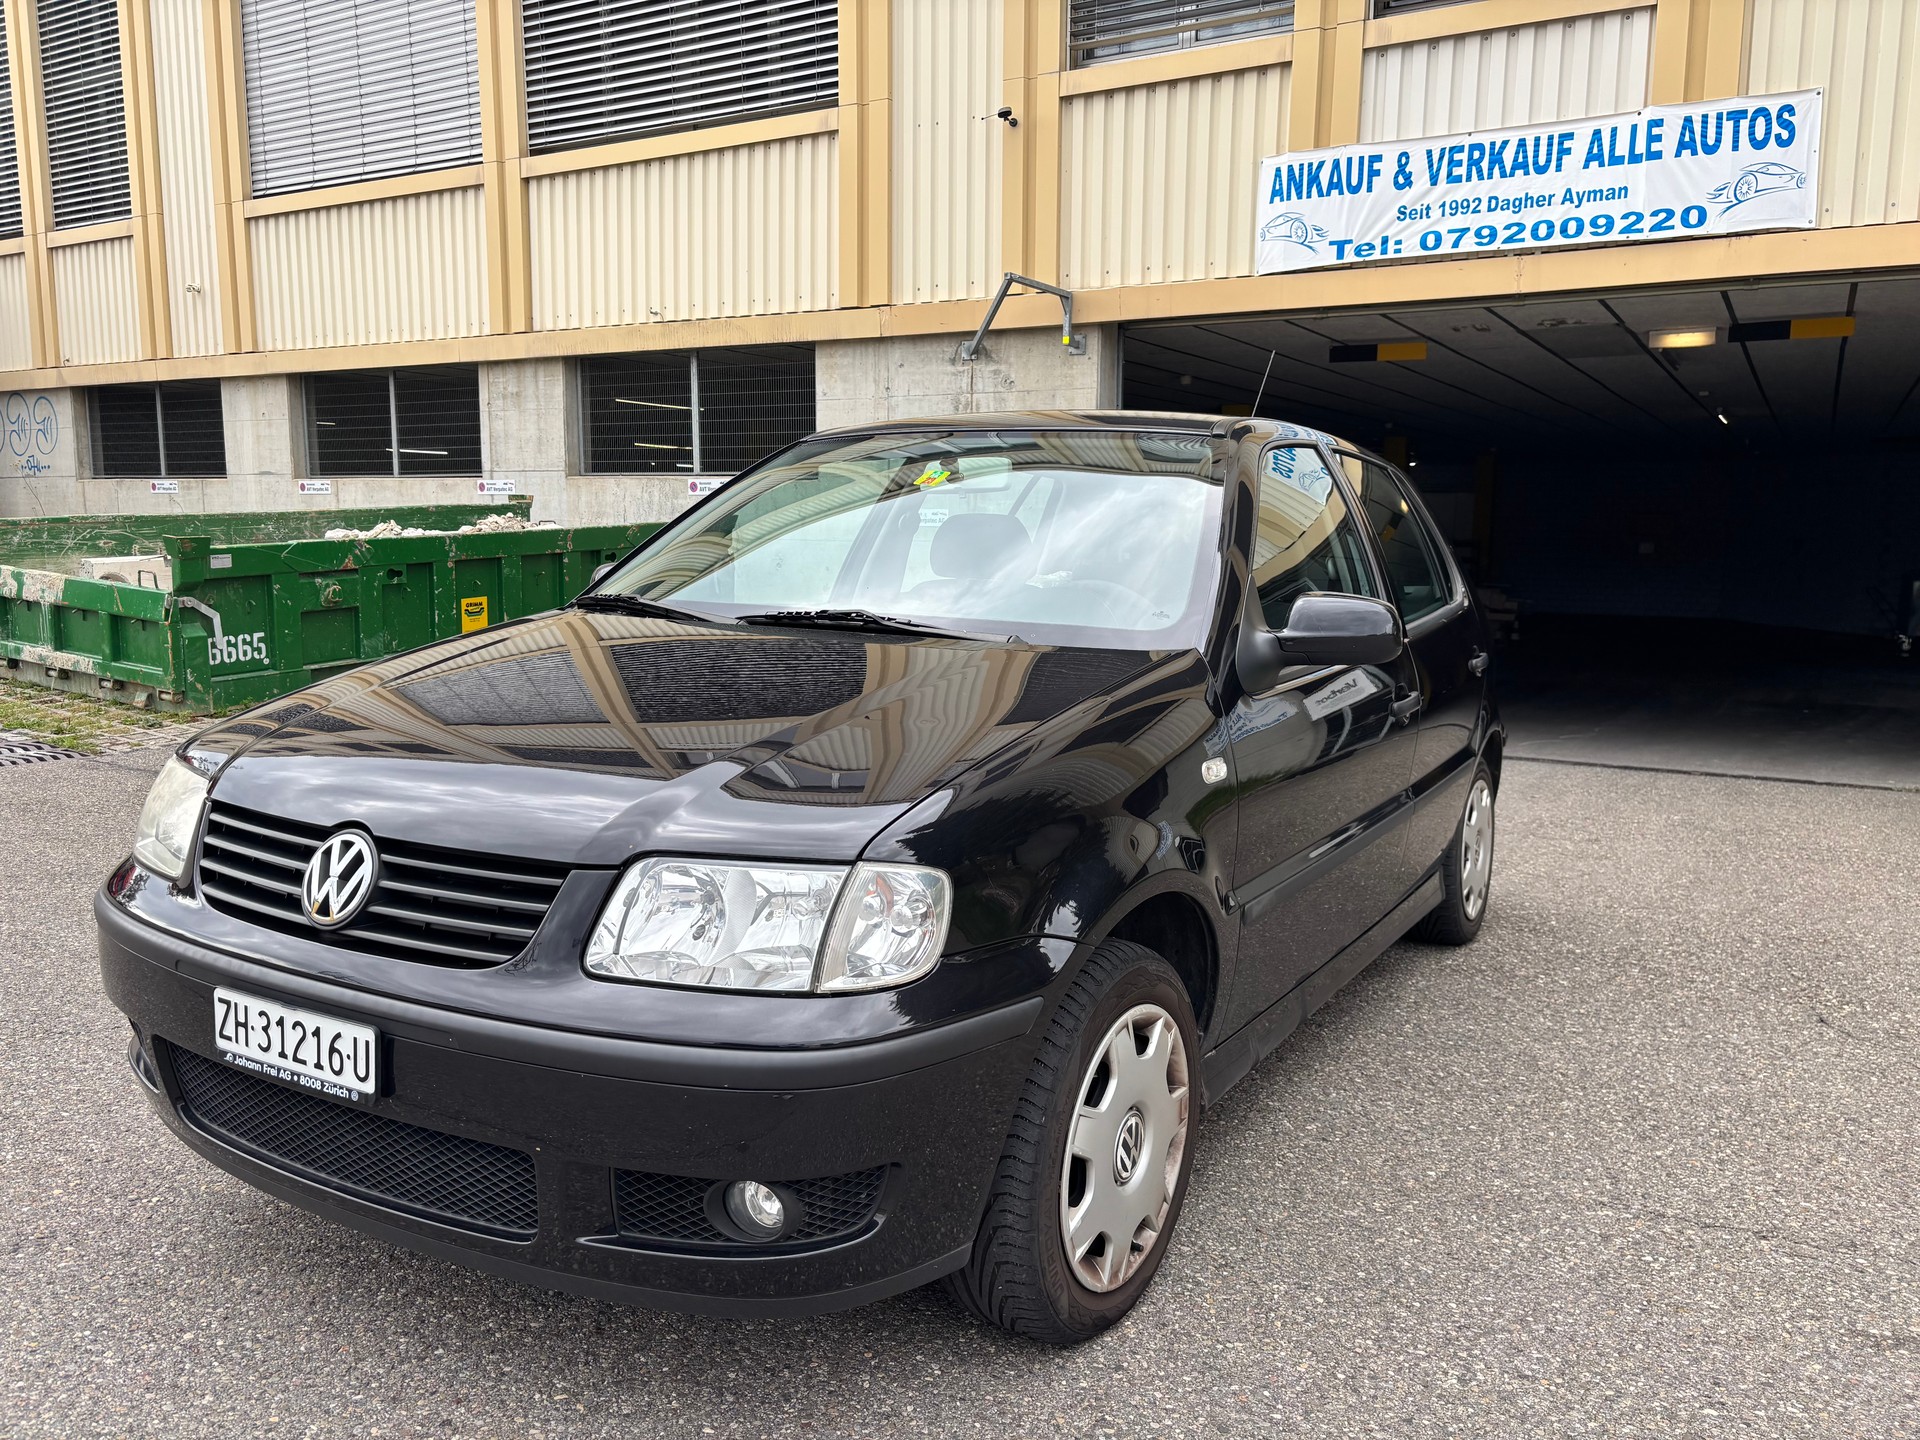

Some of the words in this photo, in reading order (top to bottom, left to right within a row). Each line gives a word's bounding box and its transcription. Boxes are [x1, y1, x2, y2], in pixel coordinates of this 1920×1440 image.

[1269, 154, 1383, 204] ANKAUF
[1393, 151, 1413, 191] &
[1425, 131, 1575, 187] VERKAUF
[1582, 117, 1665, 170] ALLE
[1674, 103, 1797, 159] AUTOS
[1396, 203, 1431, 222] Seit
[1439, 196, 1481, 218] 1992
[1487, 192, 1555, 215] Dagher
[1561, 183, 1629, 209] Ayman
[1328, 235, 1402, 261] Tel:
[1419, 204, 1708, 252] 0792009220
[208, 631, 267, 666] 6665
[234, 1055, 262, 1071] Johann
[263, 1064, 278, 1077] Frei
[279, 1069, 292, 1081] AG
[299, 1076, 322, 1089] 8008
[323, 1082, 349, 1099] Zürich
